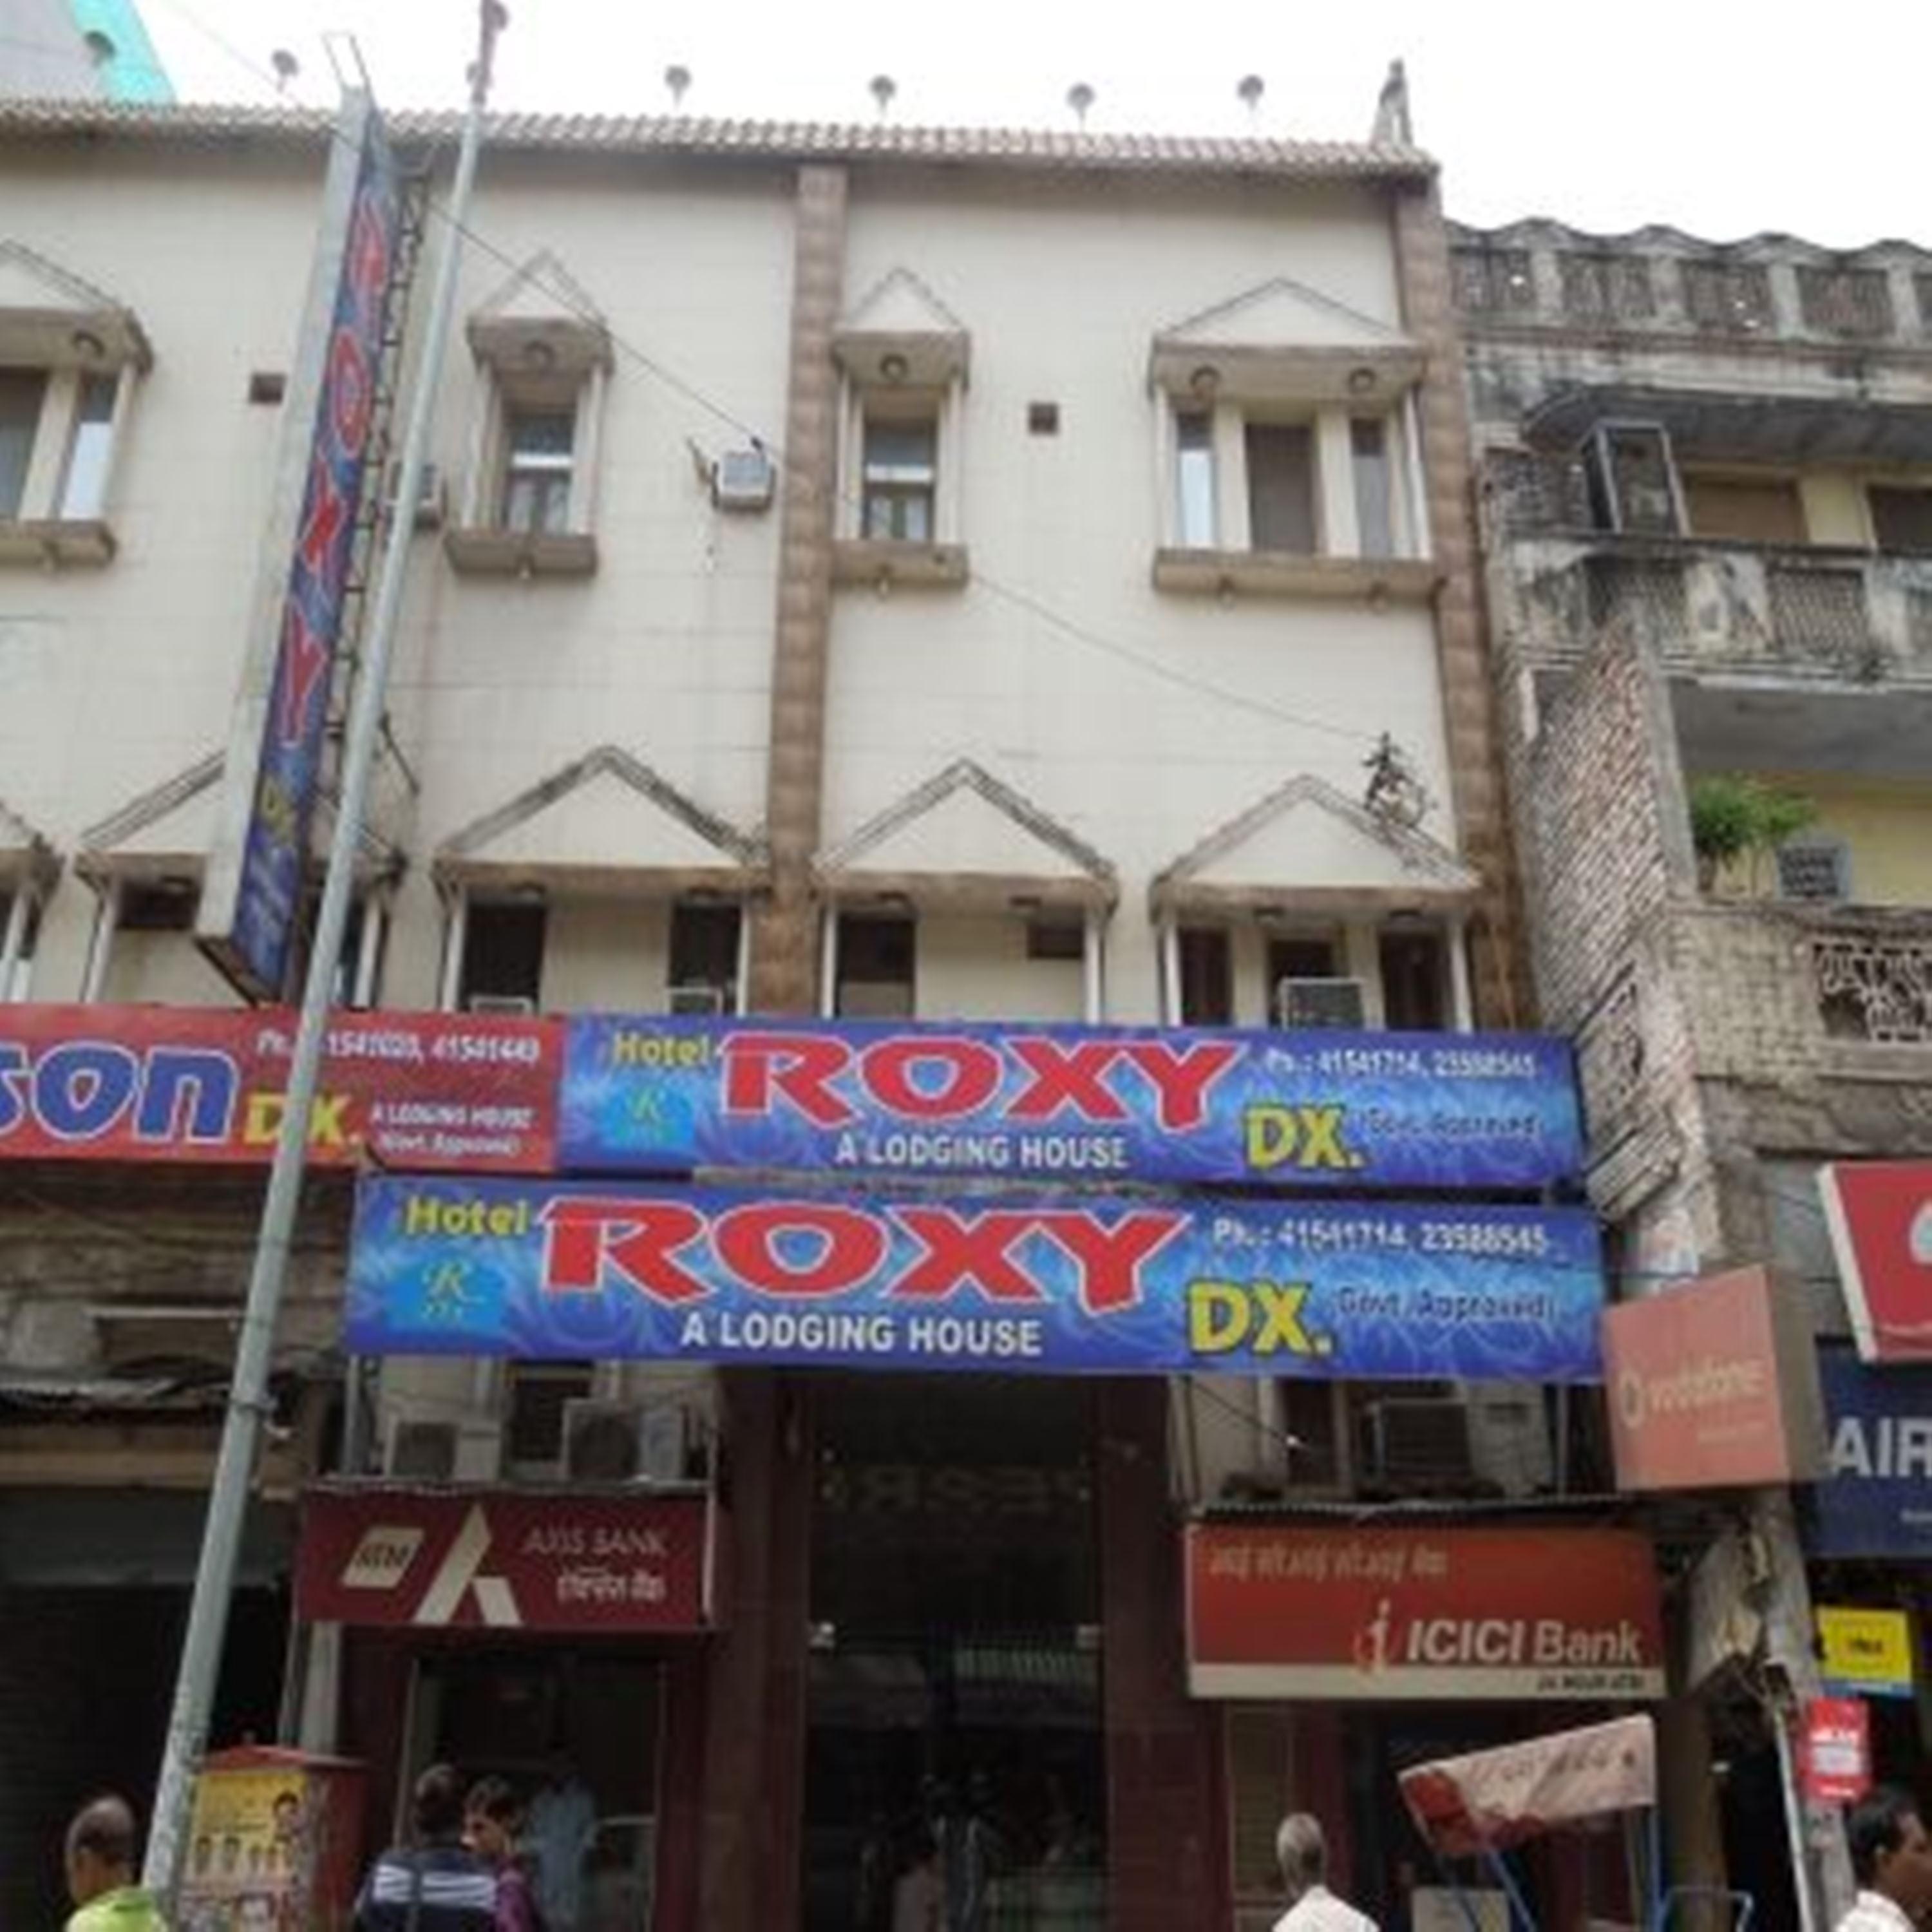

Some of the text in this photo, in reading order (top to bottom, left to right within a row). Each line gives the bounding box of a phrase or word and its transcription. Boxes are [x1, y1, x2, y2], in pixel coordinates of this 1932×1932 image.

[612, 1030, 1249, 1135] Hotel ROXY
[835, 1133, 1128, 1170] A LODGING HOUSE
[1244, 1103, 1367, 1170] DX.
[406, 1194, 1195, 1316] Hotel ROXY
[680, 1312, 1042, 1355] A LODGING HOUSE
[1188, 1280, 1333, 1354] DX.
[521, 1526, 668, 1557] AXIS BANK
[1405, 1619, 1642, 1663] ICICI Bank
